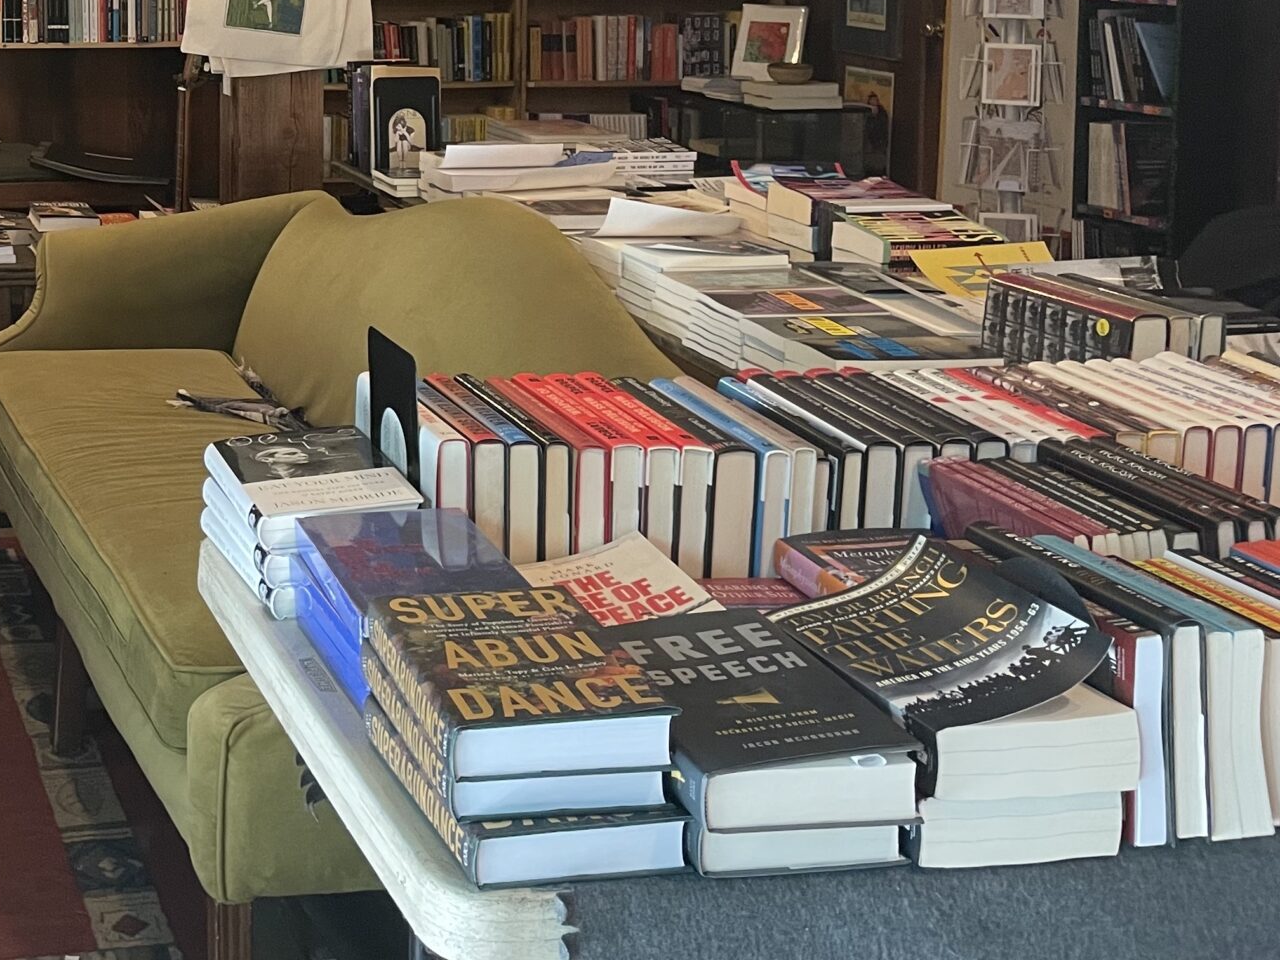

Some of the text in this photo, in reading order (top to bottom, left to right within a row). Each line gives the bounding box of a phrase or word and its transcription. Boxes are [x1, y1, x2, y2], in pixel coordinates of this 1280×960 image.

[602, 407, 642, 434] DELUSION
[633, 406, 674, 433] DELUSION
[1071, 449, 1139, 482] WOKE RACISM
[1099, 449, 1169, 481] WOKE RACISM
[258, 482, 294, 492] EAT
[295, 477, 343, 488] YOUR
[344, 471, 391, 482] MIND
[273, 498, 328, 511] JASON
[538, 562, 614, 582] LEONARD
[551, 562, 596, 576] MARK
[1042, 550, 1081, 569] KING
[553, 570, 623, 596] THE
[614, 577, 652, 603] OF
[786, 600, 866, 627] TAYLOR
[868, 547, 941, 605] BRANCH
[388, 588, 580, 625] SUPER
[801, 559, 969, 646] PARTING
[834, 613, 858, 623] PILLAR
[869, 604, 884, 613] FIRE
[885, 598, 899, 607] AND
[494, 623, 525, 632] Human
[847, 597, 1020, 678] WATERS
[444, 630, 607, 671] ABUN
[618, 621, 791, 665] FREE
[822, 626, 918, 661] THE
[504, 668, 529, 678] Tupy
[541, 665, 564, 673] Gale
[644, 650, 809, 688] SPEECH
[874, 638, 1009, 689] AMERICA IN THE KING YEARS
[373, 620, 446, 756] SUPERABUNDANCE
[447, 673, 665, 722] DANCE
[366, 658, 445, 798] SUPERABUNDANCE
[713, 725, 768, 737] SOCRATES
[784, 717, 822, 730] SOCIAL
[822, 711, 856, 723] MEDIA
[788, 708, 818, 719] FROM
[741, 739, 780, 751] JACOB
[370, 715, 466, 865] SUPERABUNDANCE
